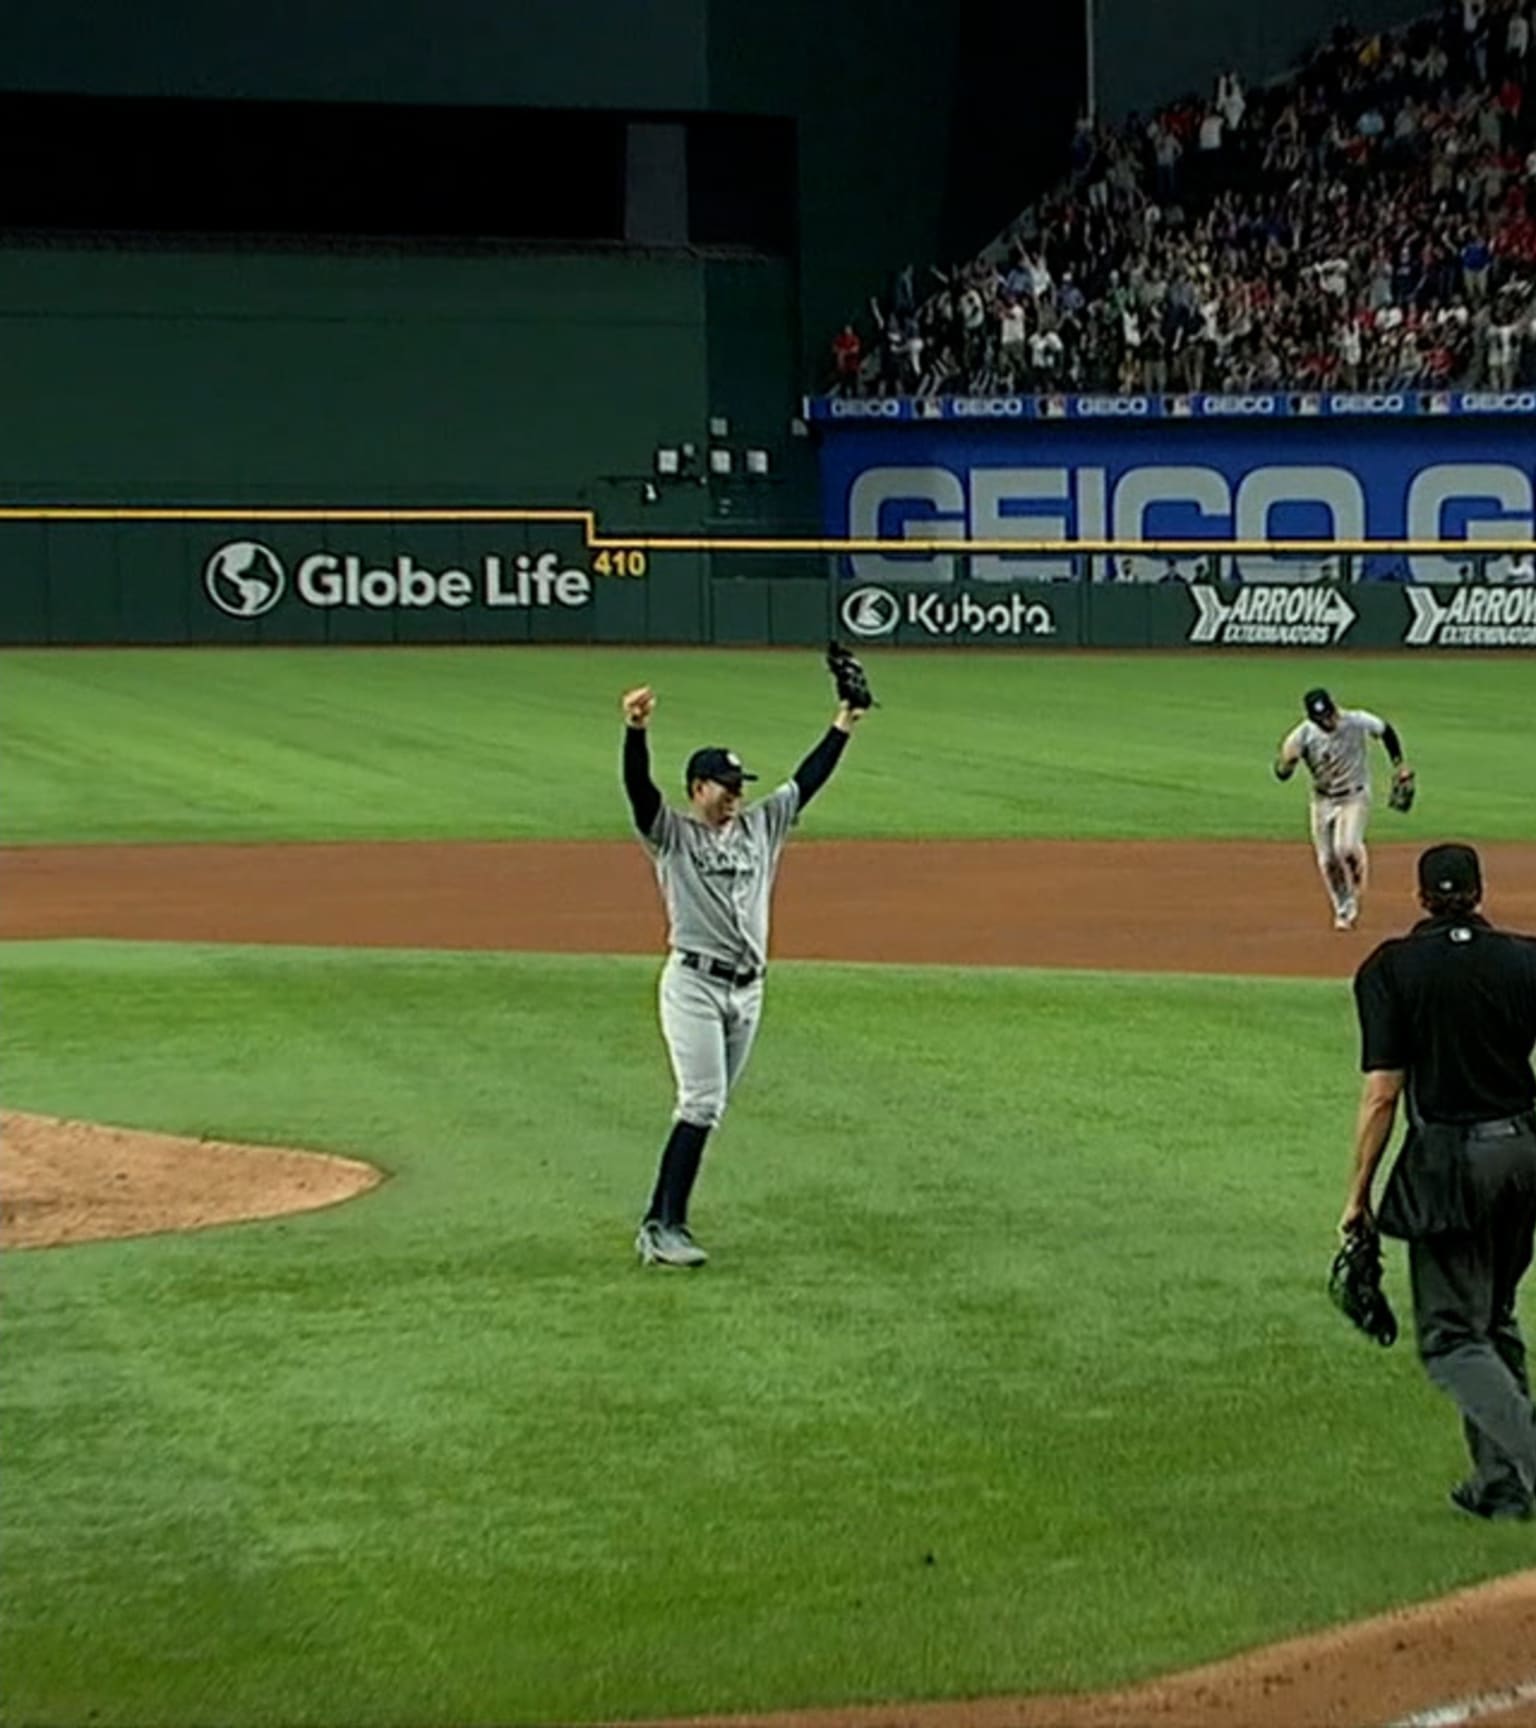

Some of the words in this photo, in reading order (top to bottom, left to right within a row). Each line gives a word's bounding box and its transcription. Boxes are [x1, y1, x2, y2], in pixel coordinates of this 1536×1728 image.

[831, 398, 899, 417] GEICO
[953, 397, 1022, 416] GEICO
[1077, 397, 1147, 415] GEICO
[1203, 395, 1274, 414] GEICO
[1331, 394, 1404, 413] GEICO
[1460, 392, 1536, 411] GEICO
[849, 466, 1366, 583] GEICO
[593, 551, 646, 577] 410
[298, 554, 472, 607] Globe
[484, 554, 591, 607] Life
[1229, 586, 1335, 624] ARROW
[908, 594, 1050, 636] Kubota
